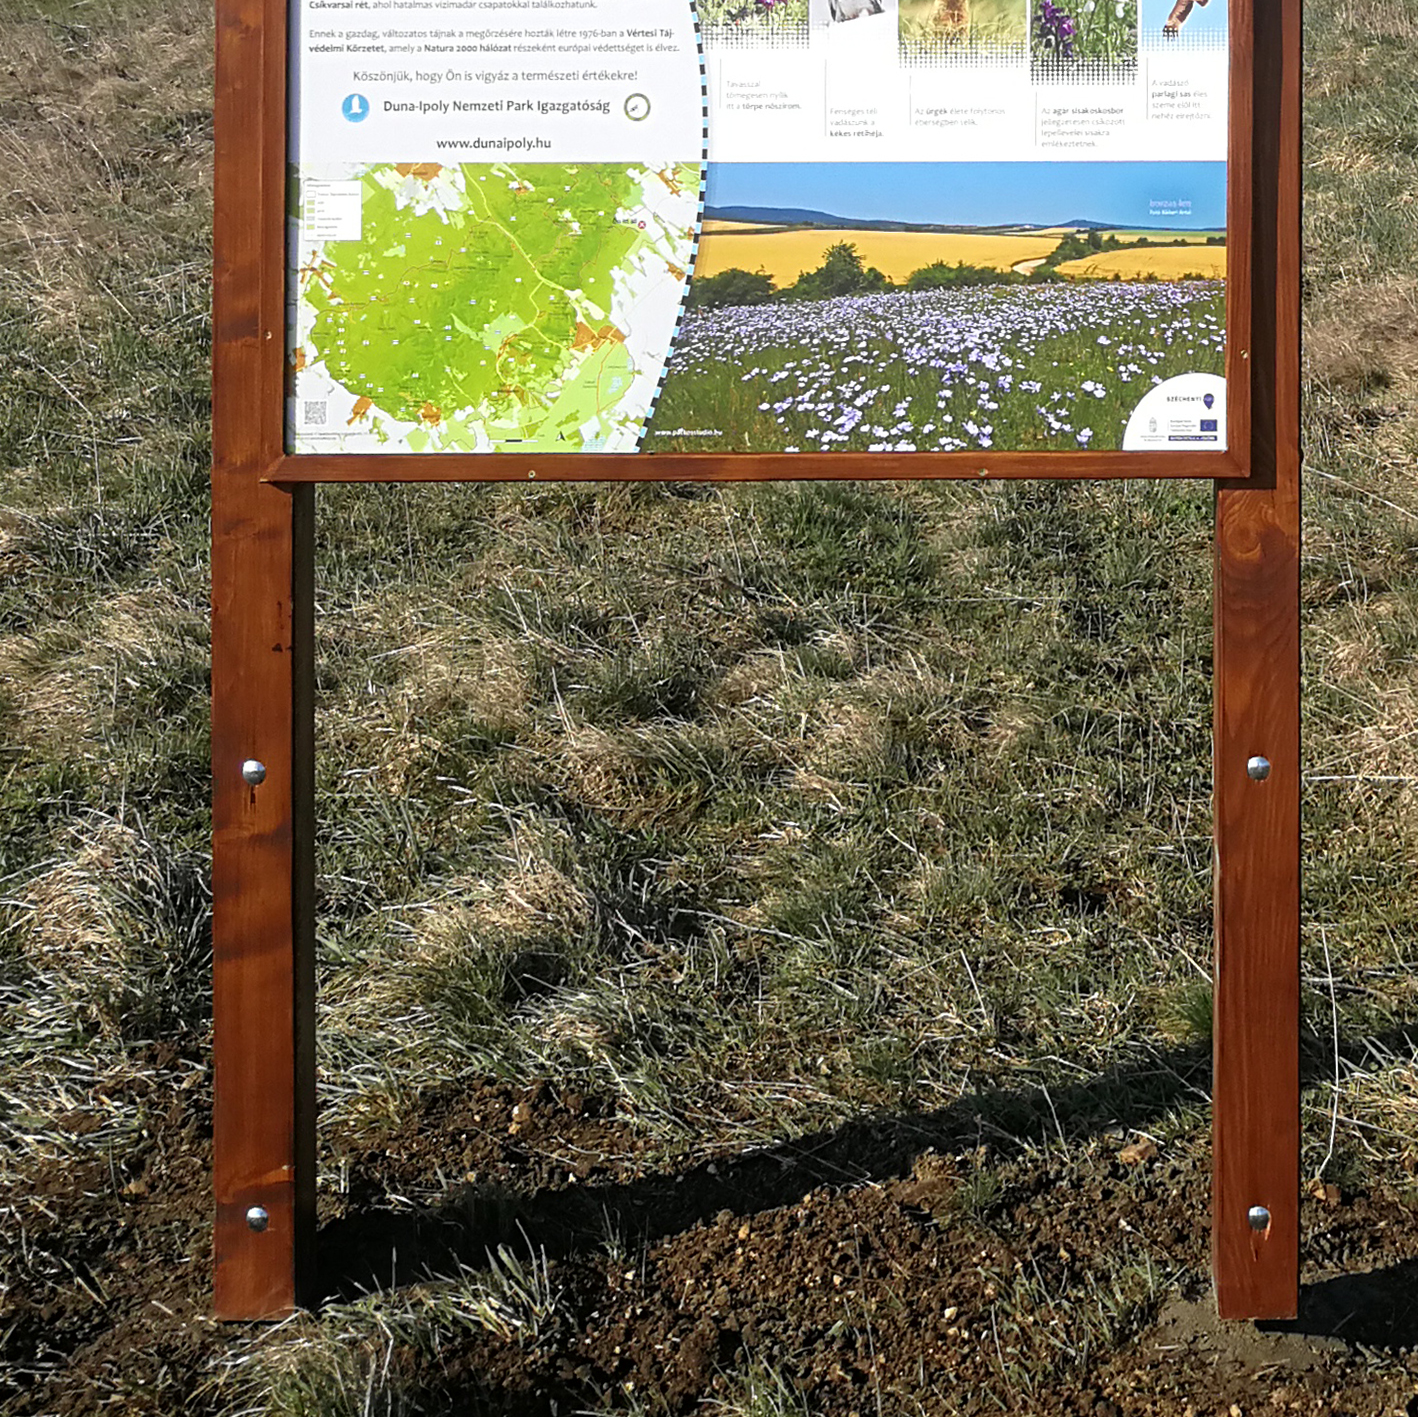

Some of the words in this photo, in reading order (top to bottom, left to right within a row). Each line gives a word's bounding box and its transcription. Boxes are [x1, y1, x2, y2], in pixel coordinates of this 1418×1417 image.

[353, 68, 413, 84] Köszönjük,
[415, 68, 443, 84] hogy
[445, 68, 462, 80] Ön
[464, 68, 473, 80] is
[475, 68, 509, 84] vigyáz
[512, 71, 518, 80] a
[521, 68, 579, 80] természeti
[582, 68, 638, 80] értékekre!
[384, 98, 450, 116] Duna-Ipoly
[453, 98, 503, 111] Nemzeti
[506, 98, 534, 111] Park
[537, 98, 610, 116] Igazgatóság
[436, 136, 551, 151] www.dunaipoly.hu
